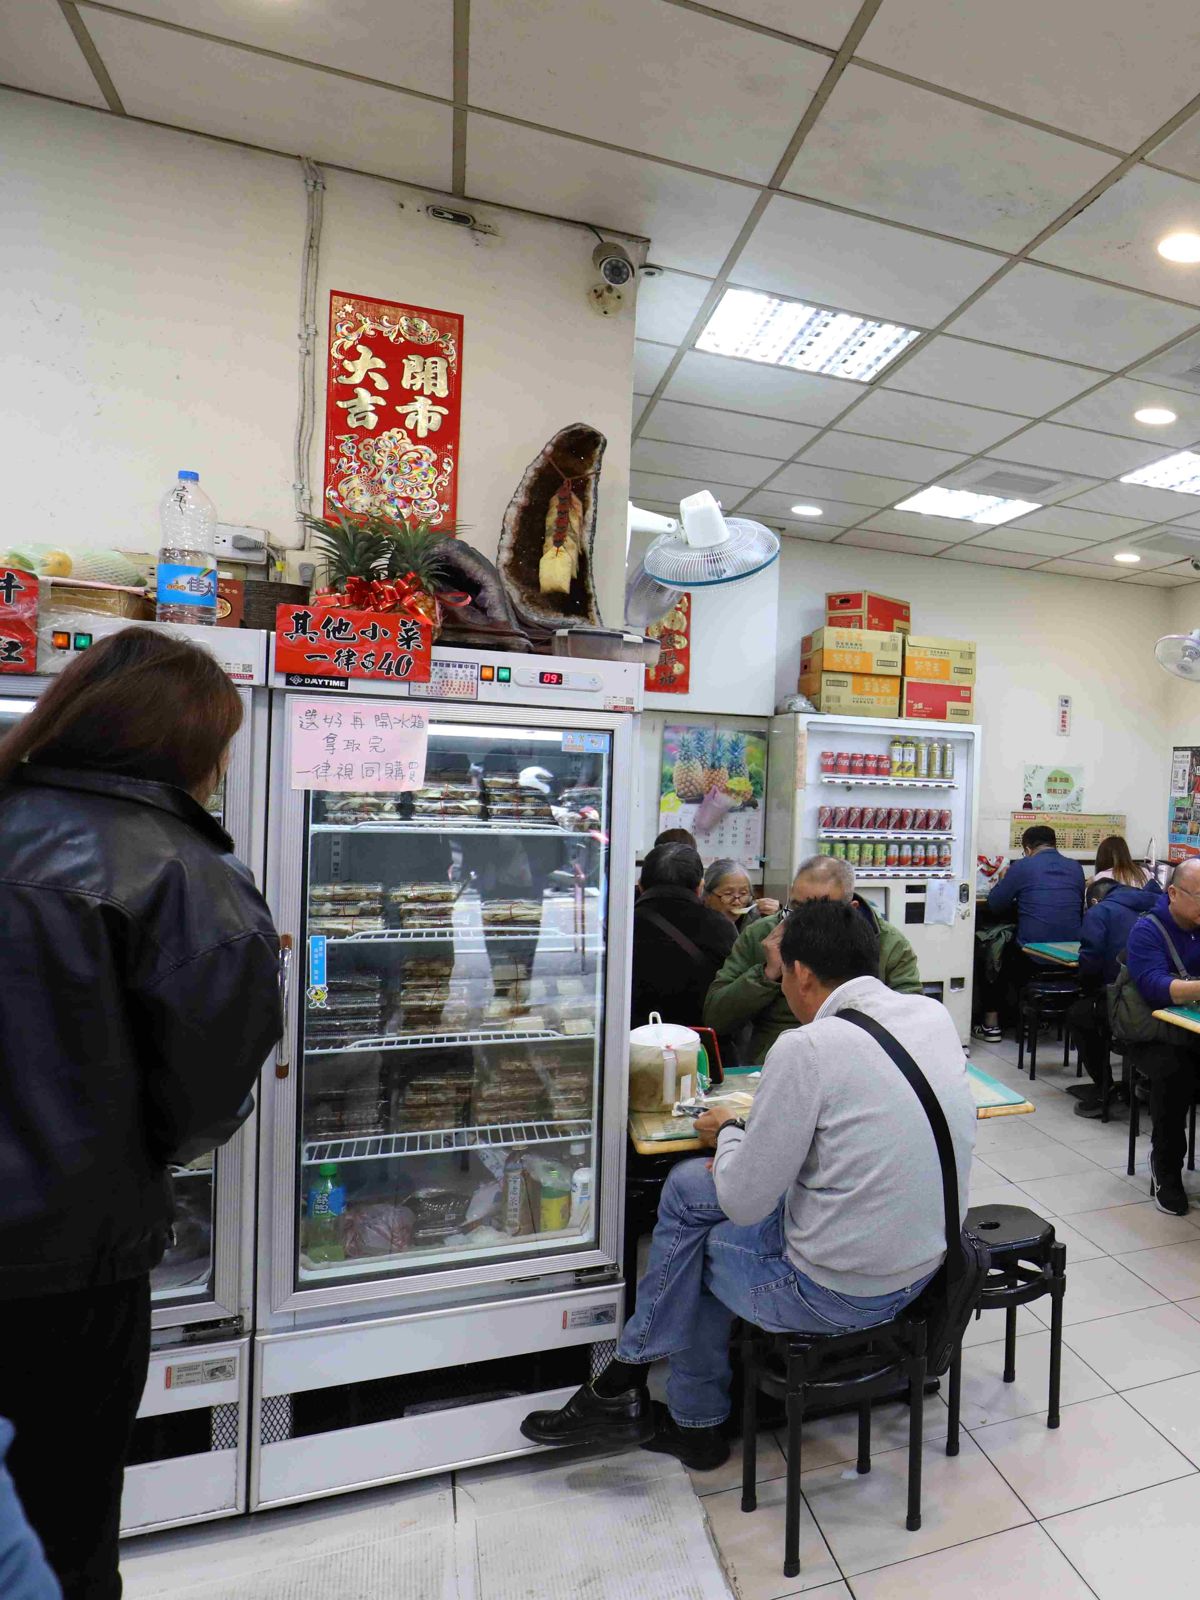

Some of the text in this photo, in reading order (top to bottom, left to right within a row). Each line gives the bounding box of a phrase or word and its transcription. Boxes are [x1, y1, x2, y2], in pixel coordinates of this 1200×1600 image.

[336, 344, 389, 430] 大吉
[395, 354, 449, 438] 開市
[284, 609, 423, 651] 其他小菜
[304, 648, 414, 678] 一律$40
[304, 678, 346, 687] DAYTIME
[322, 732, 386, 755] 拿取完
